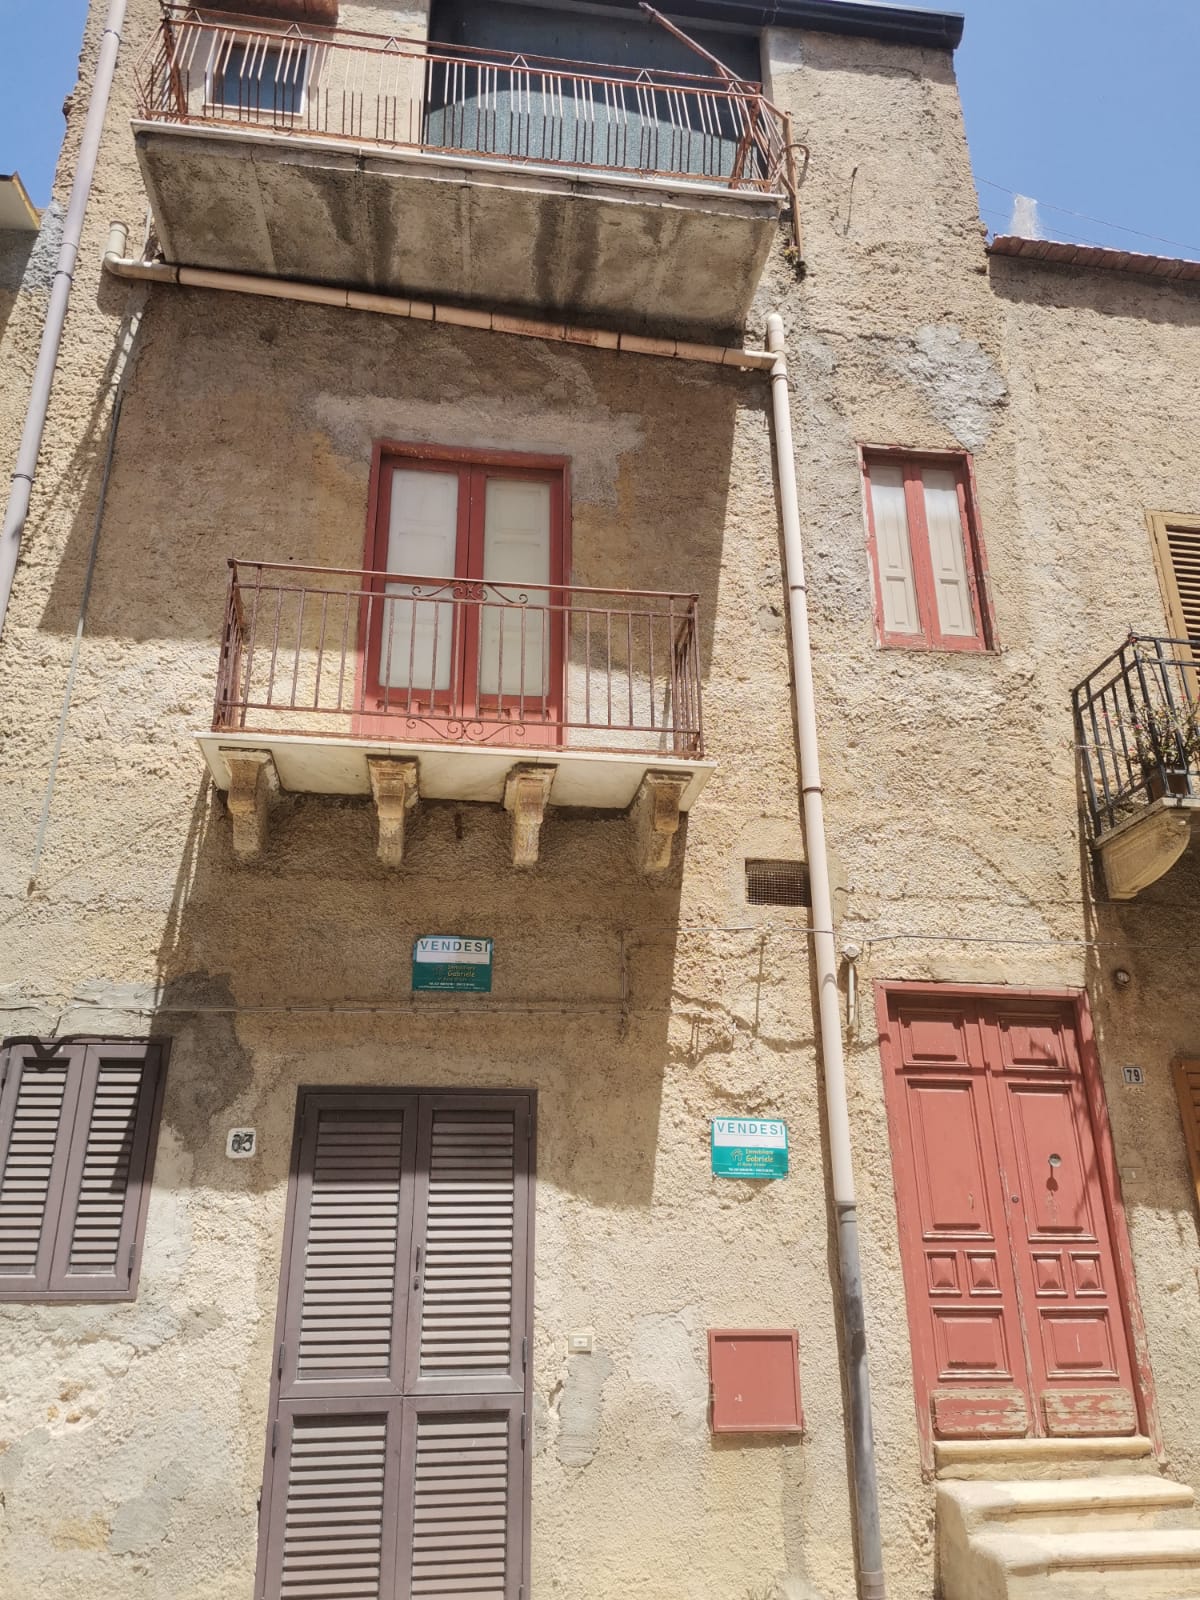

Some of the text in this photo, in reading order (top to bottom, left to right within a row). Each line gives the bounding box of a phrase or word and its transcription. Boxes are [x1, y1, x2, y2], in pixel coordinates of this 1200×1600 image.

[420, 940, 488, 952] VENDESI
[1126, 1069, 1140, 1081] 79
[717, 1122, 784, 1135] VENDESI
